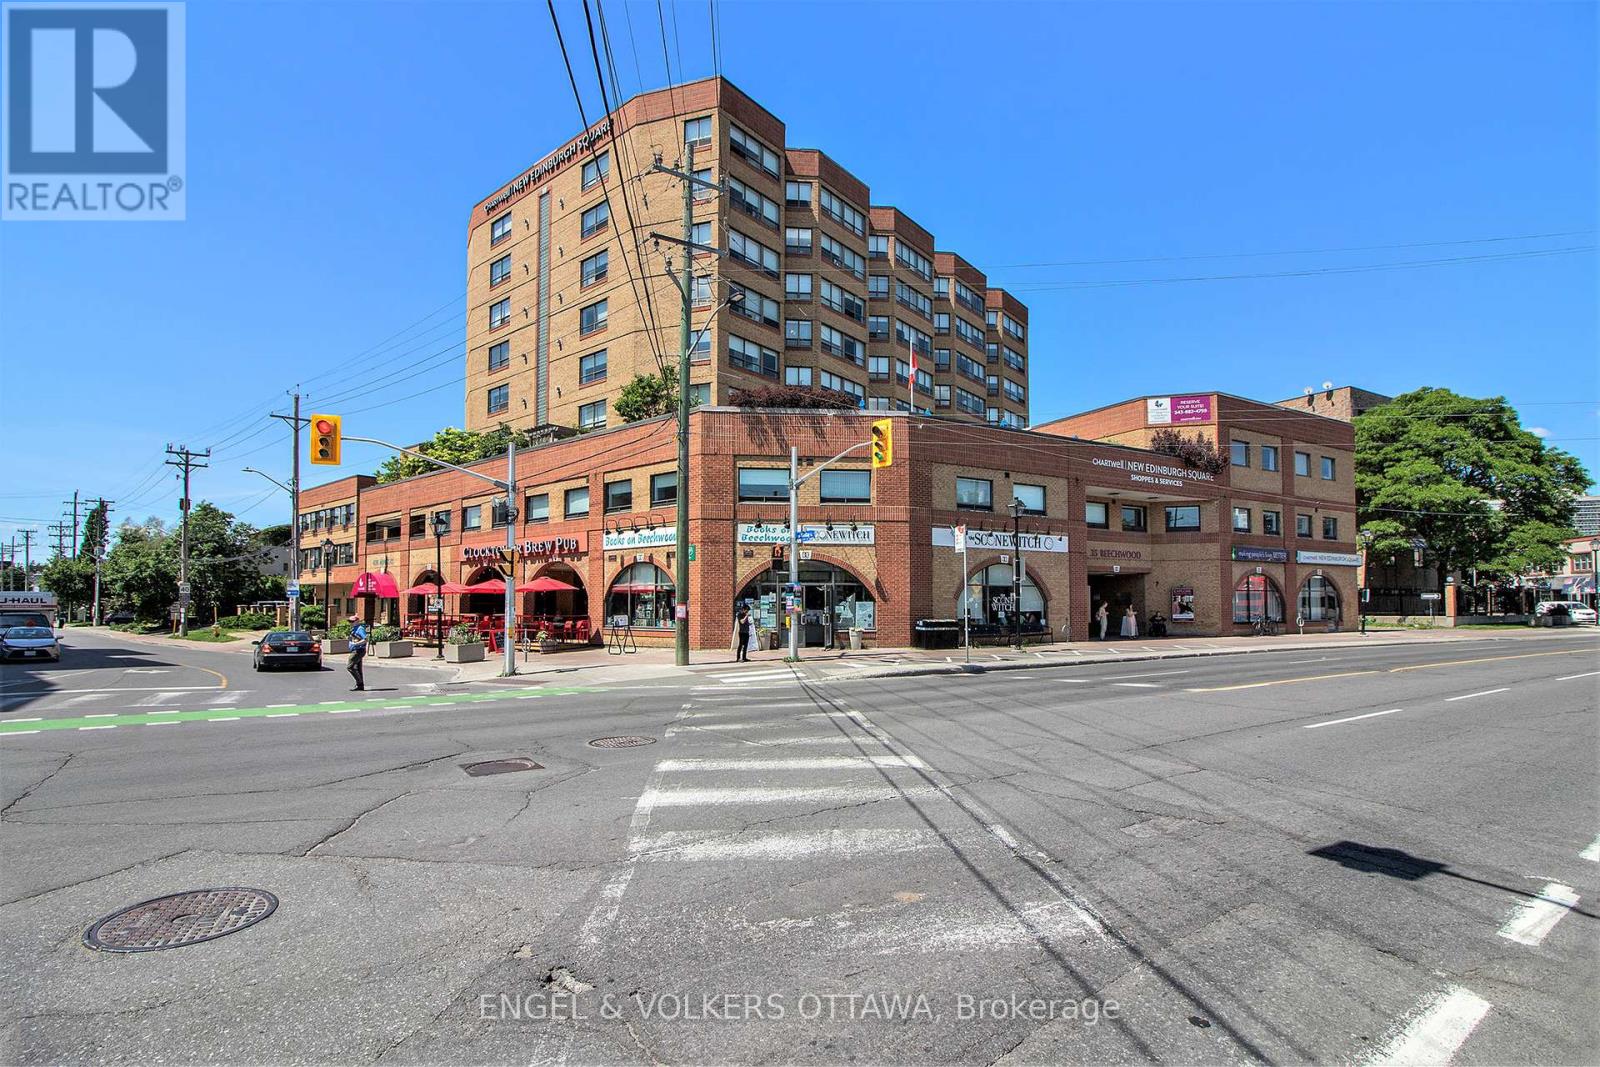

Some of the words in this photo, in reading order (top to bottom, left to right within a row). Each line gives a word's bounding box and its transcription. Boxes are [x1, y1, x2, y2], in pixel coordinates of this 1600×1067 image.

[513, 174, 530, 191] NEW
[530, 143, 576, 181] EDINBURGH
[1127, 461, 1144, 472] NEW
[1145, 463, 1187, 478] EDINBURGH
[1131, 474, 1154, 484] SHOPPES
[1159, 478, 1183, 487] SERVICES
[524, 540, 552, 554] BREW
[555, 536, 577, 551] PUB
